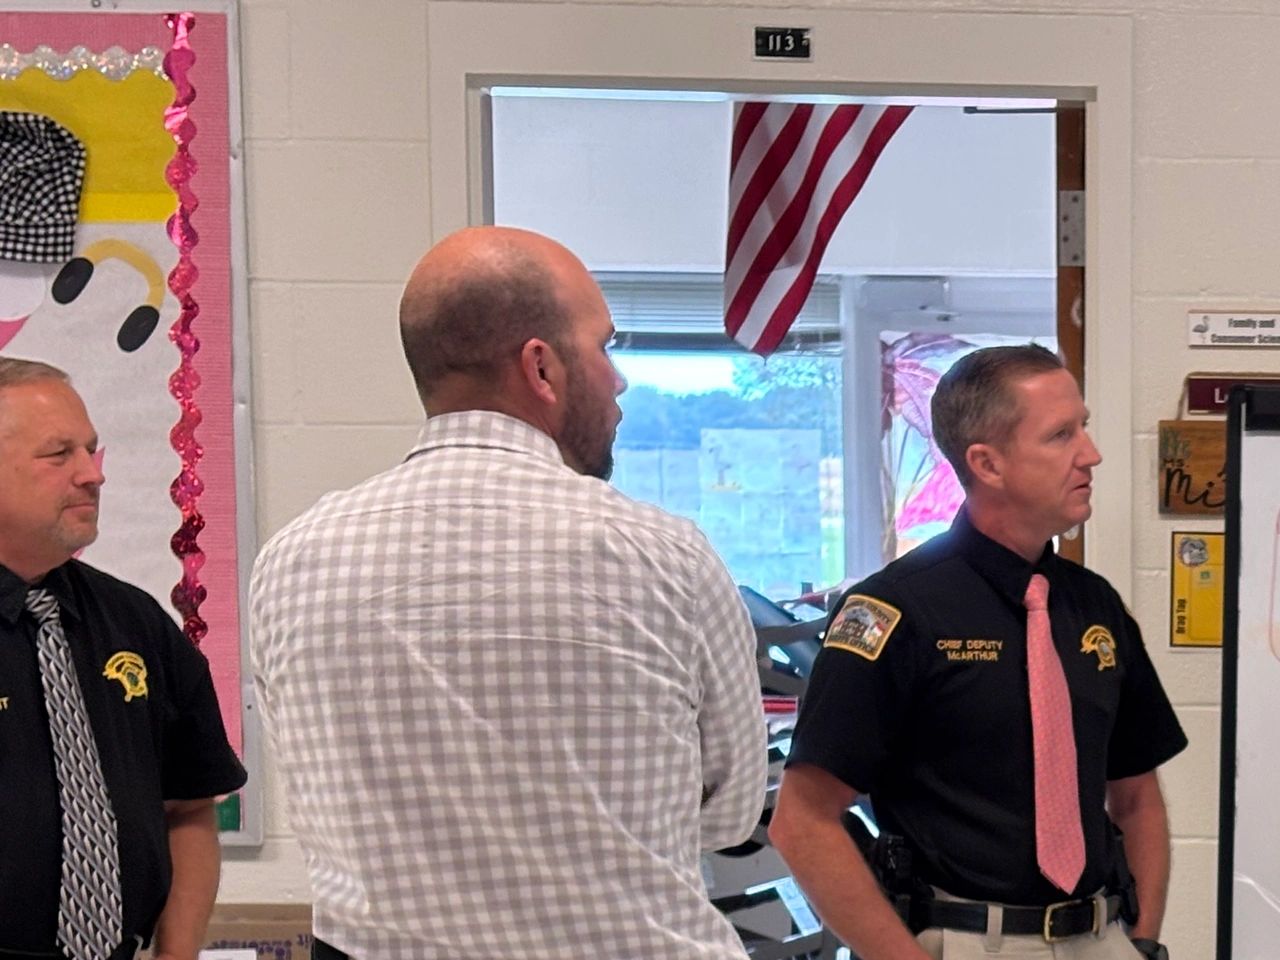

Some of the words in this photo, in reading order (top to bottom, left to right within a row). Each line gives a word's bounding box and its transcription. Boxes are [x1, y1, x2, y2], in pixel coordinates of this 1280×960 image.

[768, 34, 795, 52] 113
[1228, 318, 1257, 330] Family
[1259, 318, 1275, 328] and
[1211, 333, 1255, 344] Consumer
[936, 639, 963, 650] CHIEF
[966, 639, 1003, 651] DEPUTY
